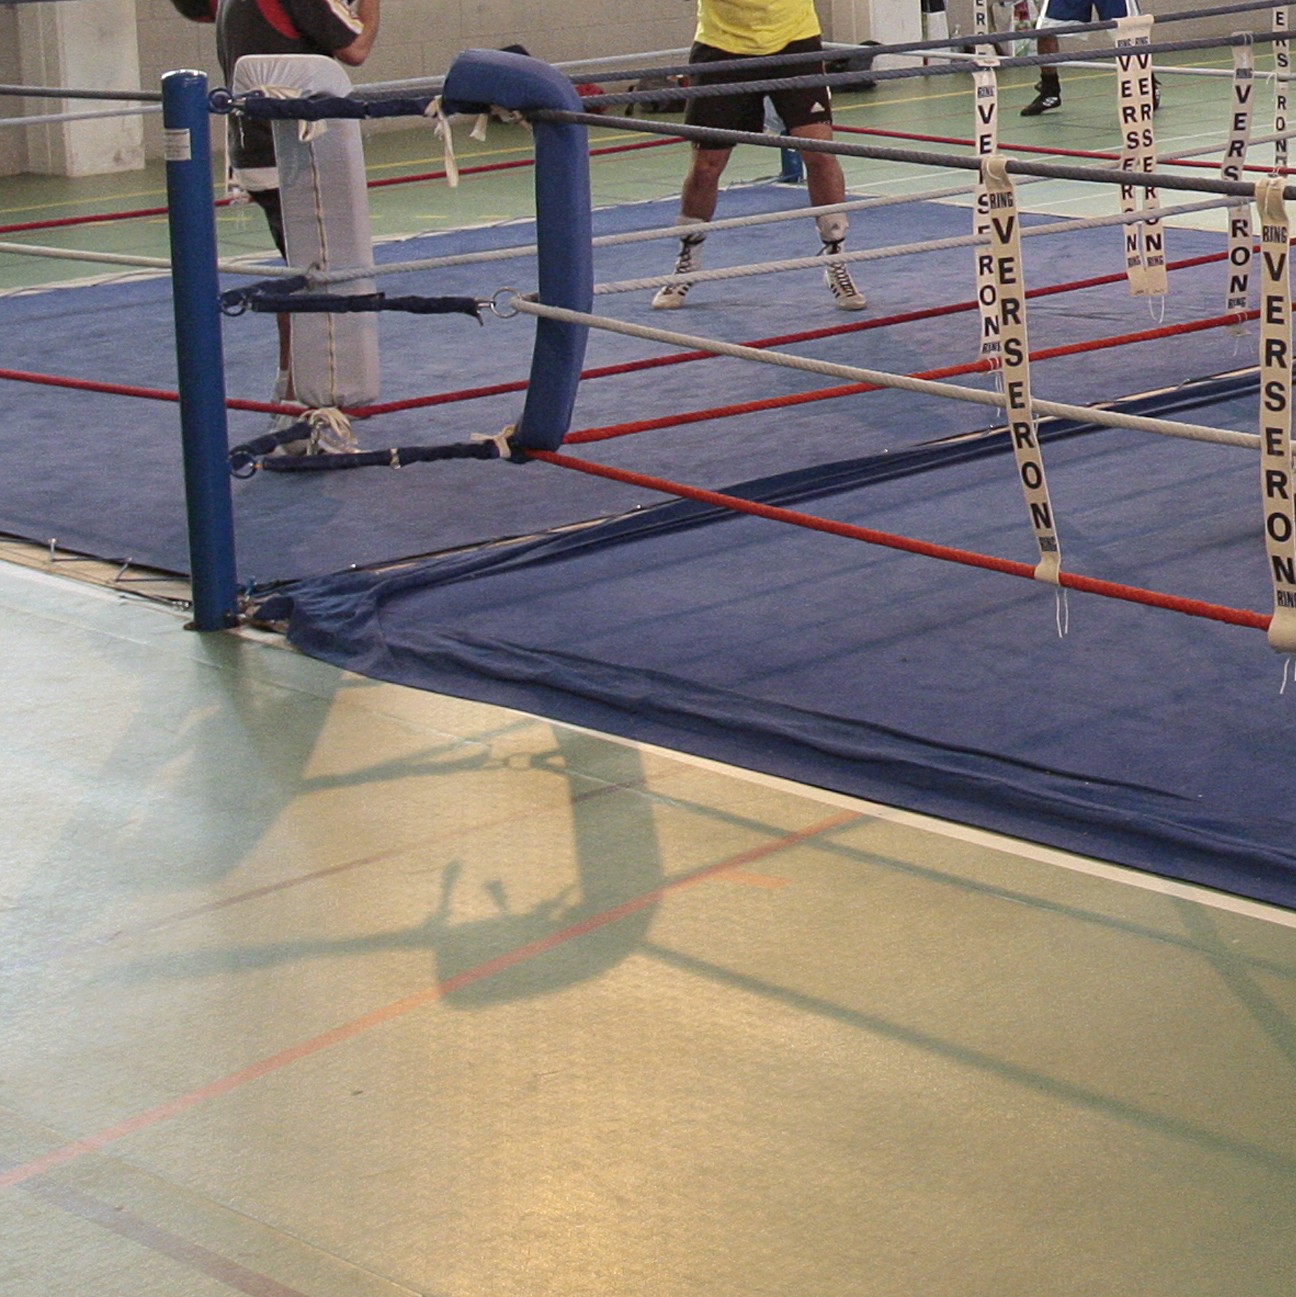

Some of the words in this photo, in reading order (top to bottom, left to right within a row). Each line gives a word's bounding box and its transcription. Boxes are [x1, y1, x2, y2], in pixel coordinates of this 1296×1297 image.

[989, 191, 1013, 209] RING
[1262, 225, 1287, 244] RING
[992, 216, 1053, 530] VERSERON
[1263, 251, 1296, 585] VERSERON
